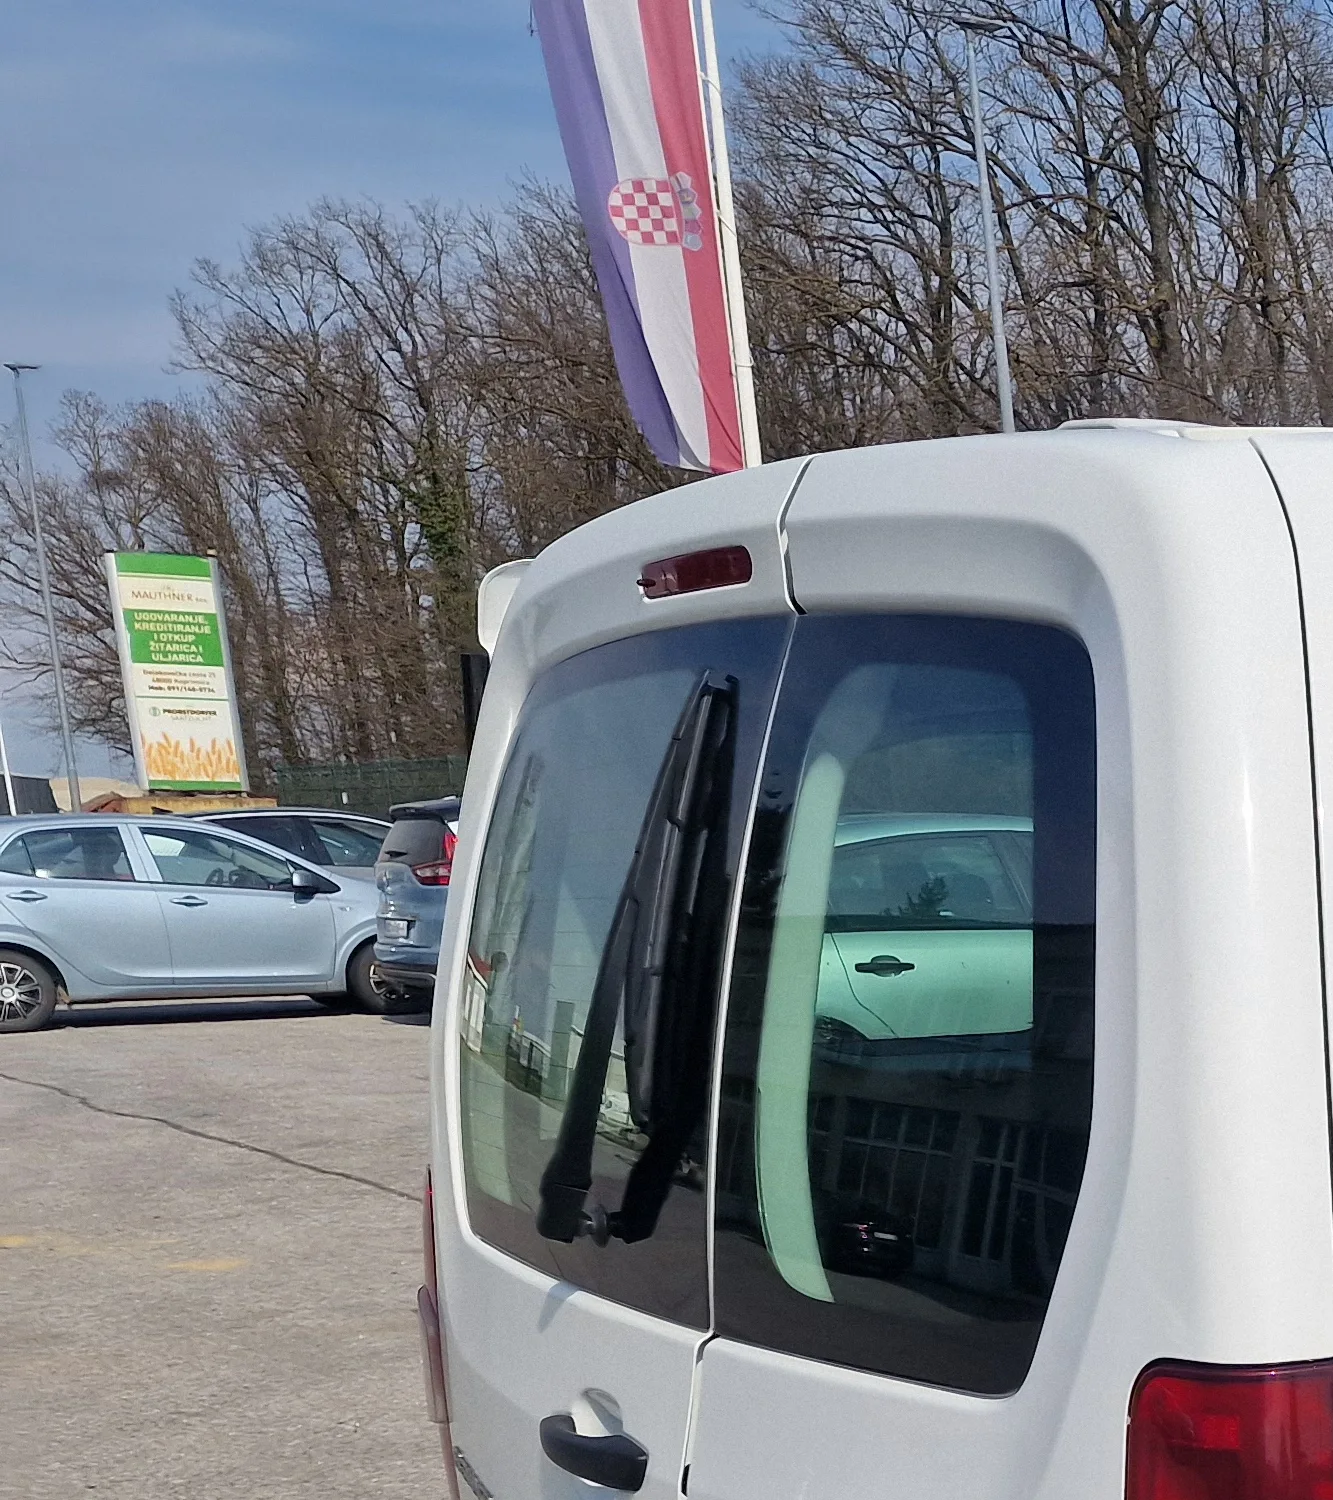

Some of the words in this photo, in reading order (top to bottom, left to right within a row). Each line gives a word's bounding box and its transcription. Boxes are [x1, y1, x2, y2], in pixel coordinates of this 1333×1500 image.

[131, 590, 194, 602] MAUTHNER
[134, 621, 212, 634] KREDITIRANJE
[160, 633, 196, 642] OTKUP
[149, 640, 198, 652] ŽITARICA
[151, 652, 204, 662] ULJARICA
